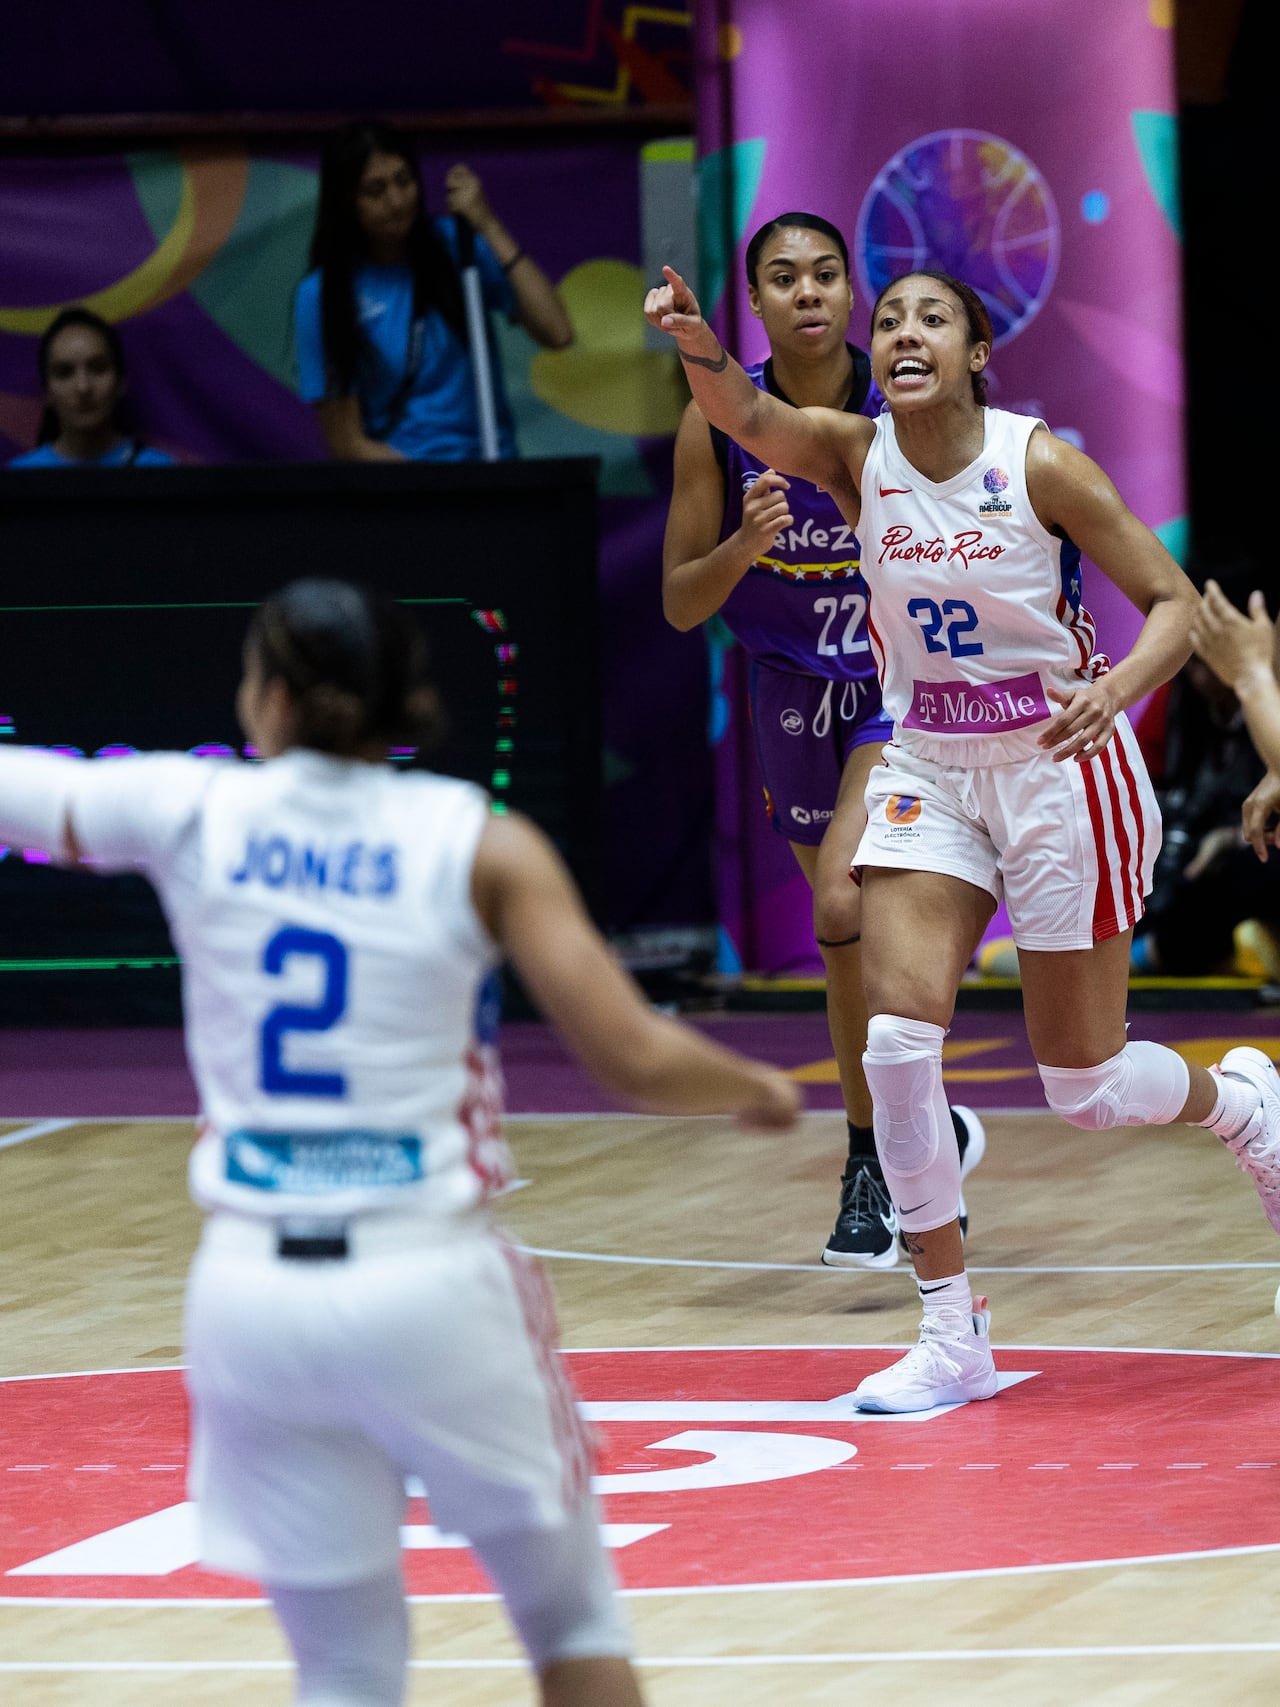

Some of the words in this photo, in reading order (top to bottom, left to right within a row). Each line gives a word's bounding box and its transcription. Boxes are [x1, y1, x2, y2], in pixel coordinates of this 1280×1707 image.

[878, 525, 945, 565] Puerto
[946, 530, 1006, 570] Rico
[814, 594, 870, 656] 22
[907, 598, 984, 658] 22
[940, 690, 1037, 724] Mobile
[227, 834, 401, 896] JONES
[260, 922, 349, 1098] 2
